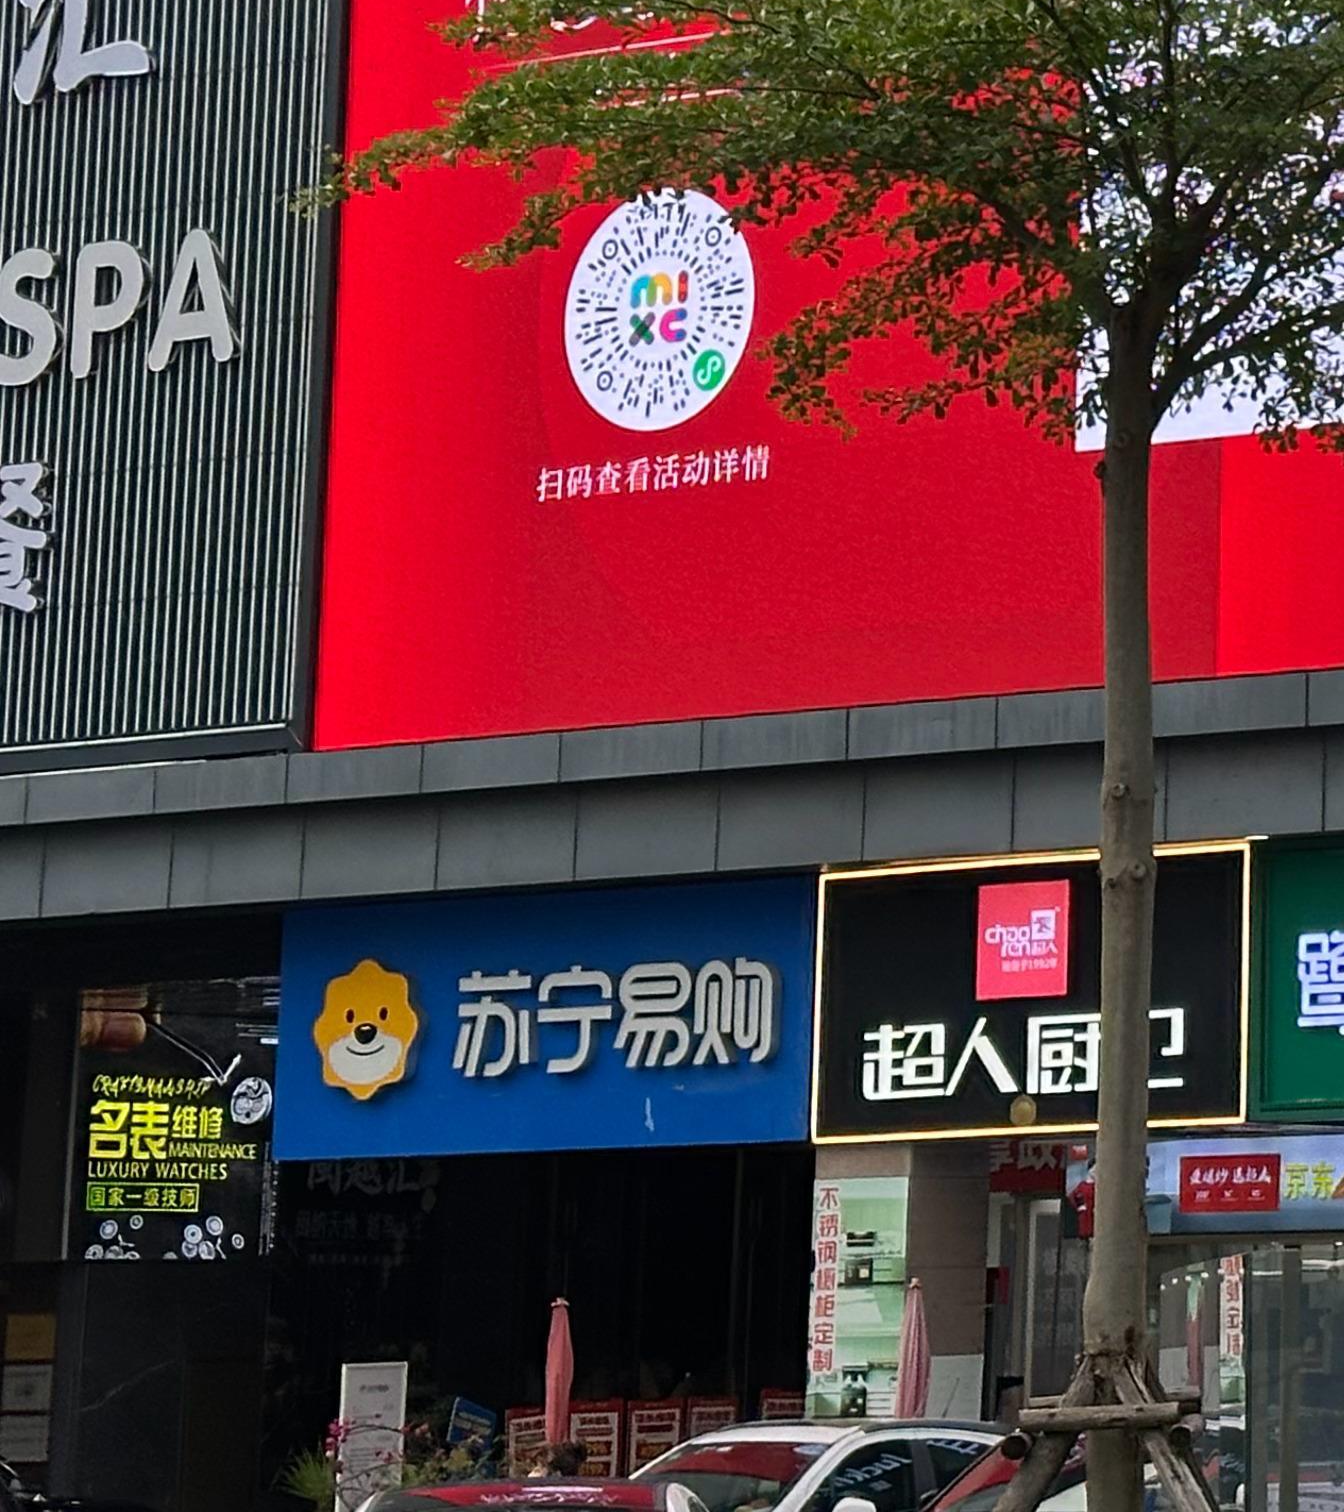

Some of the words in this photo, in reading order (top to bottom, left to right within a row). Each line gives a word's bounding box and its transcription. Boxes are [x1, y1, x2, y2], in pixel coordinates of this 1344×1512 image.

[0, 229, 238, 387] SPA
[536, 444, 770, 503] 扫码查看活动详情
[452, 957, 774, 1078] 苏宁易购
[87, 1161, 149, 1179] LUXURY
[155, 1162, 228, 1180] WATCHES
[168, 1143, 257, 1160] MAINTENANCE
